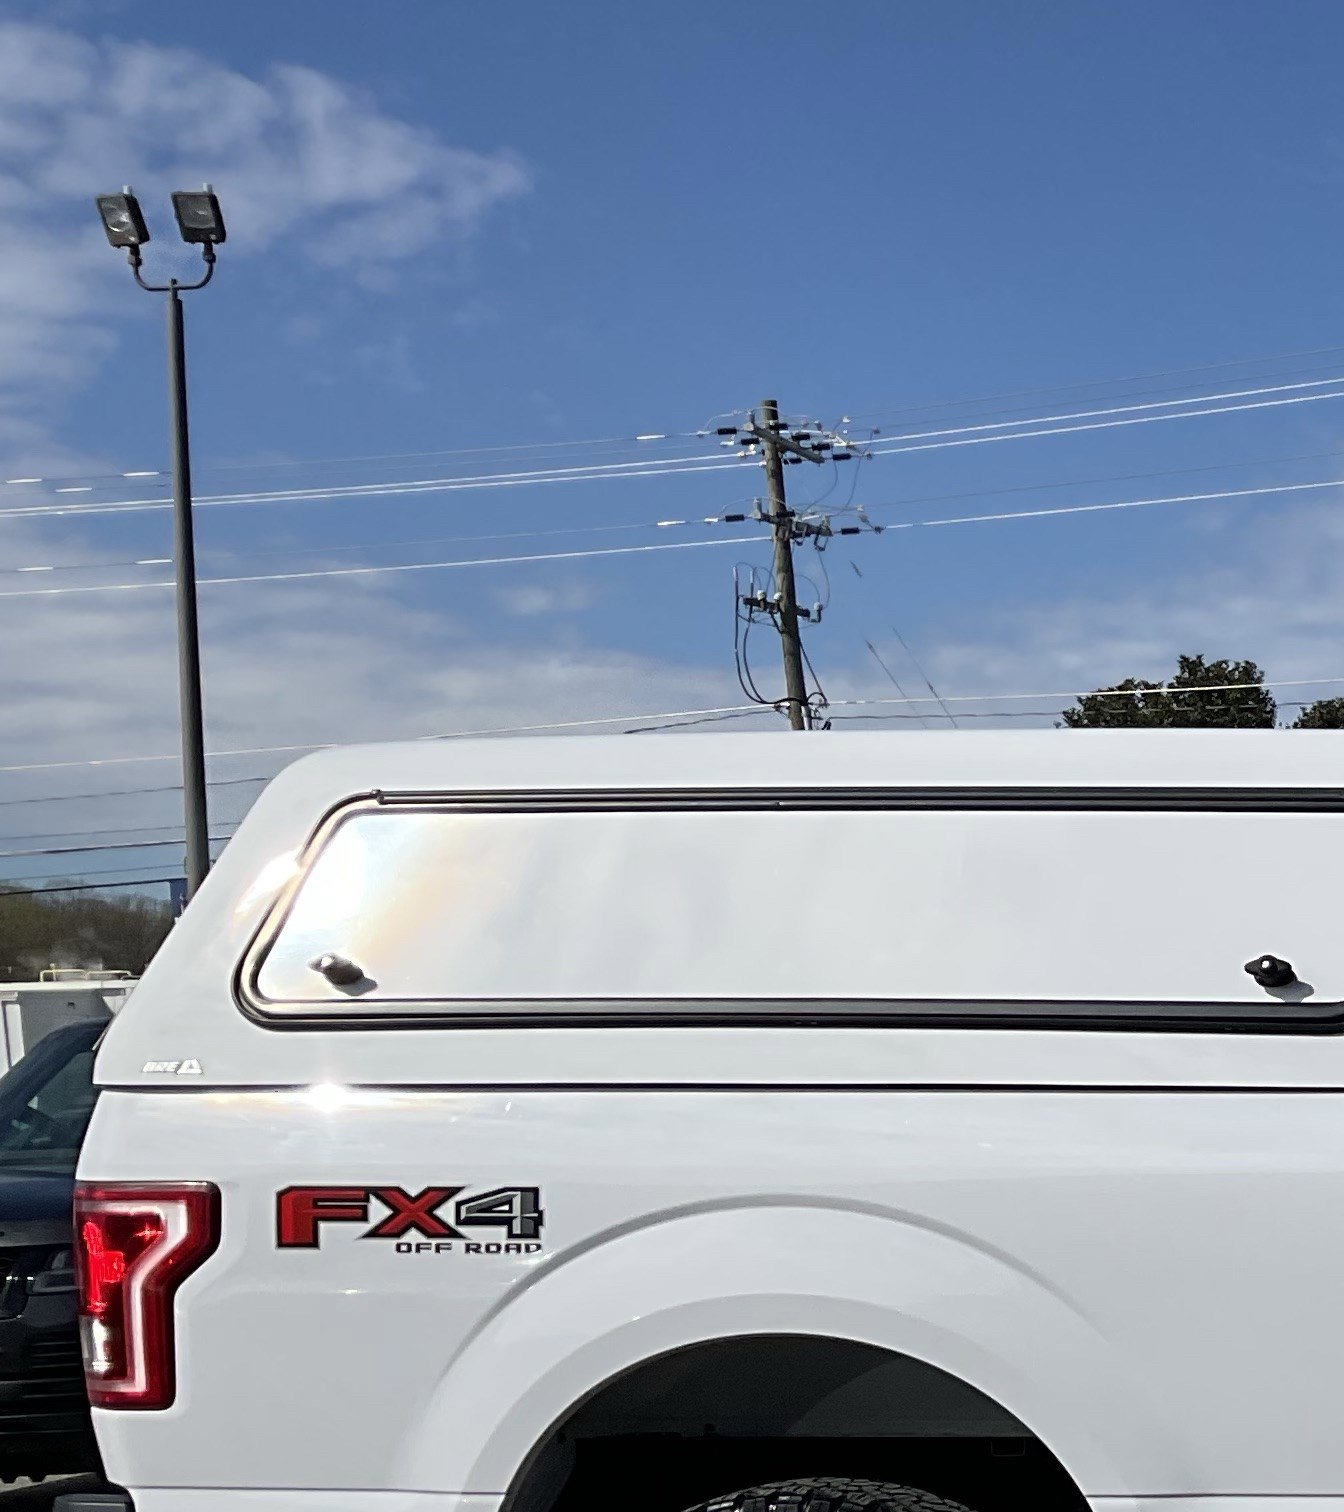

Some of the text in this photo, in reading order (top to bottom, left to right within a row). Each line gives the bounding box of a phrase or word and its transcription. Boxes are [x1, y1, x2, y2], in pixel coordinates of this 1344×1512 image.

[275, 1185, 544, 1249] FX4
[395, 1242, 543, 1255] OFF ROAD
